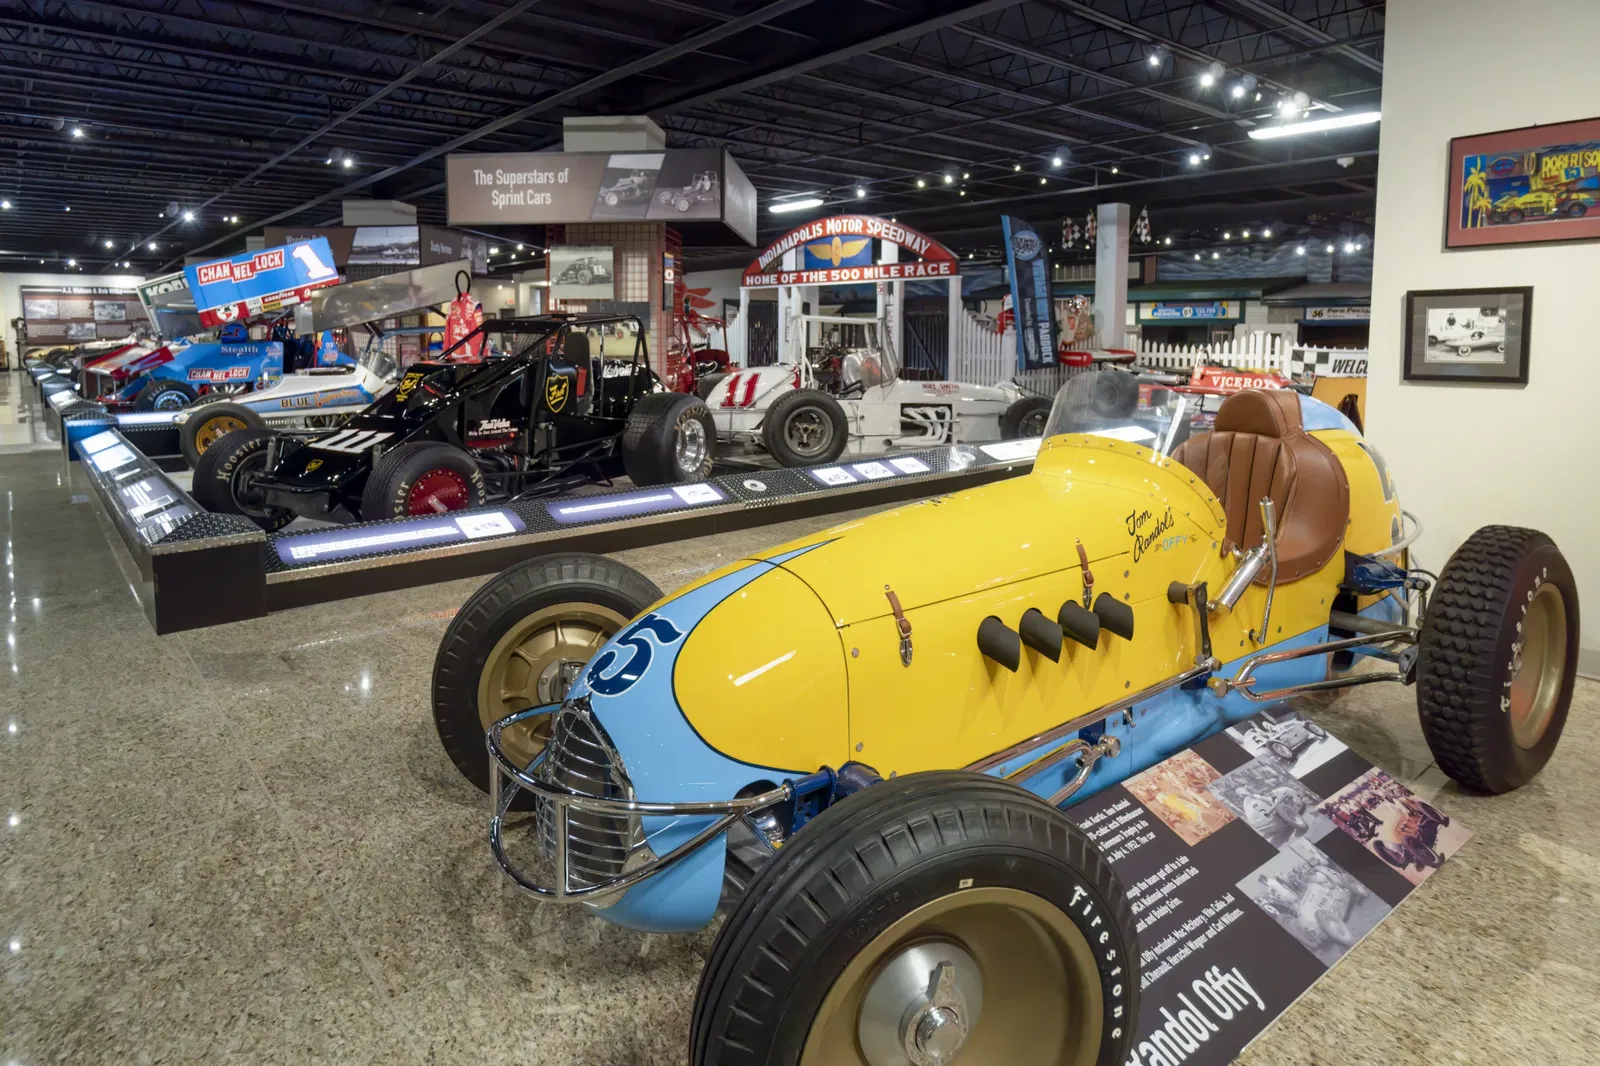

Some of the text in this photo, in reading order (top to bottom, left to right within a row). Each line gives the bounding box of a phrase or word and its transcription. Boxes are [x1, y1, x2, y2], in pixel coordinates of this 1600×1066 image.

[1542, 149, 1600, 179] ROBERTSO
[473, 167, 569, 188] The Superstars of
[491, 188, 552, 211] Sprint Cars
[758, 218, 931, 270] INDIANAPOLIS MOTOR SPEEDWAY
[292, 243, 335, 280] 1
[746, 262, 951, 286] HOME OF THE 500 MILE RACE
[221, 345, 258, 356] Stealth
[720, 373, 761, 409] 11
[1211, 375, 1274, 389] VICEROY
[281, 396, 311, 408] BLUE
[1125, 509, 1152, 536] Tom
[1133, 506, 1175, 563] Randol's
[1162, 534, 1189, 551] OFFY
[585, 612, 687, 698] 5
[1087, 822, 1111, 841] 70-cubic
[1111, 846, 1126, 858] July
[1136, 834, 1149, 844] The
[1146, 831, 1156, 840] car
[1136, 881, 1149, 891] the
[1143, 874, 1160, 886] team
[1157, 868, 1168, 880] got
[1164, 863, 1173, 874] off
[1176, 855, 1189, 865] late
[1140, 888, 1164, 907] National
[1160, 881, 1177, 897] points
[1171, 870, 1191, 886] behind
[1141, 949, 1158, 962] Offy
[1172, 928, 1188, 940] Mac
[1222, 892, 1235, 904] Jud
[1144, 912, 1157, 926] and
[1151, 904, 1172, 919] Bobby
[1211, 919, 1227, 932] Carl
[1186, 933, 1208, 951] Wagner
[1205, 925, 1218, 939] and
[1069, 885, 1123, 1039] Firestone
[1166, 944, 1192, 966] Herschel
[1191, 964, 1266, 1020] Offy
